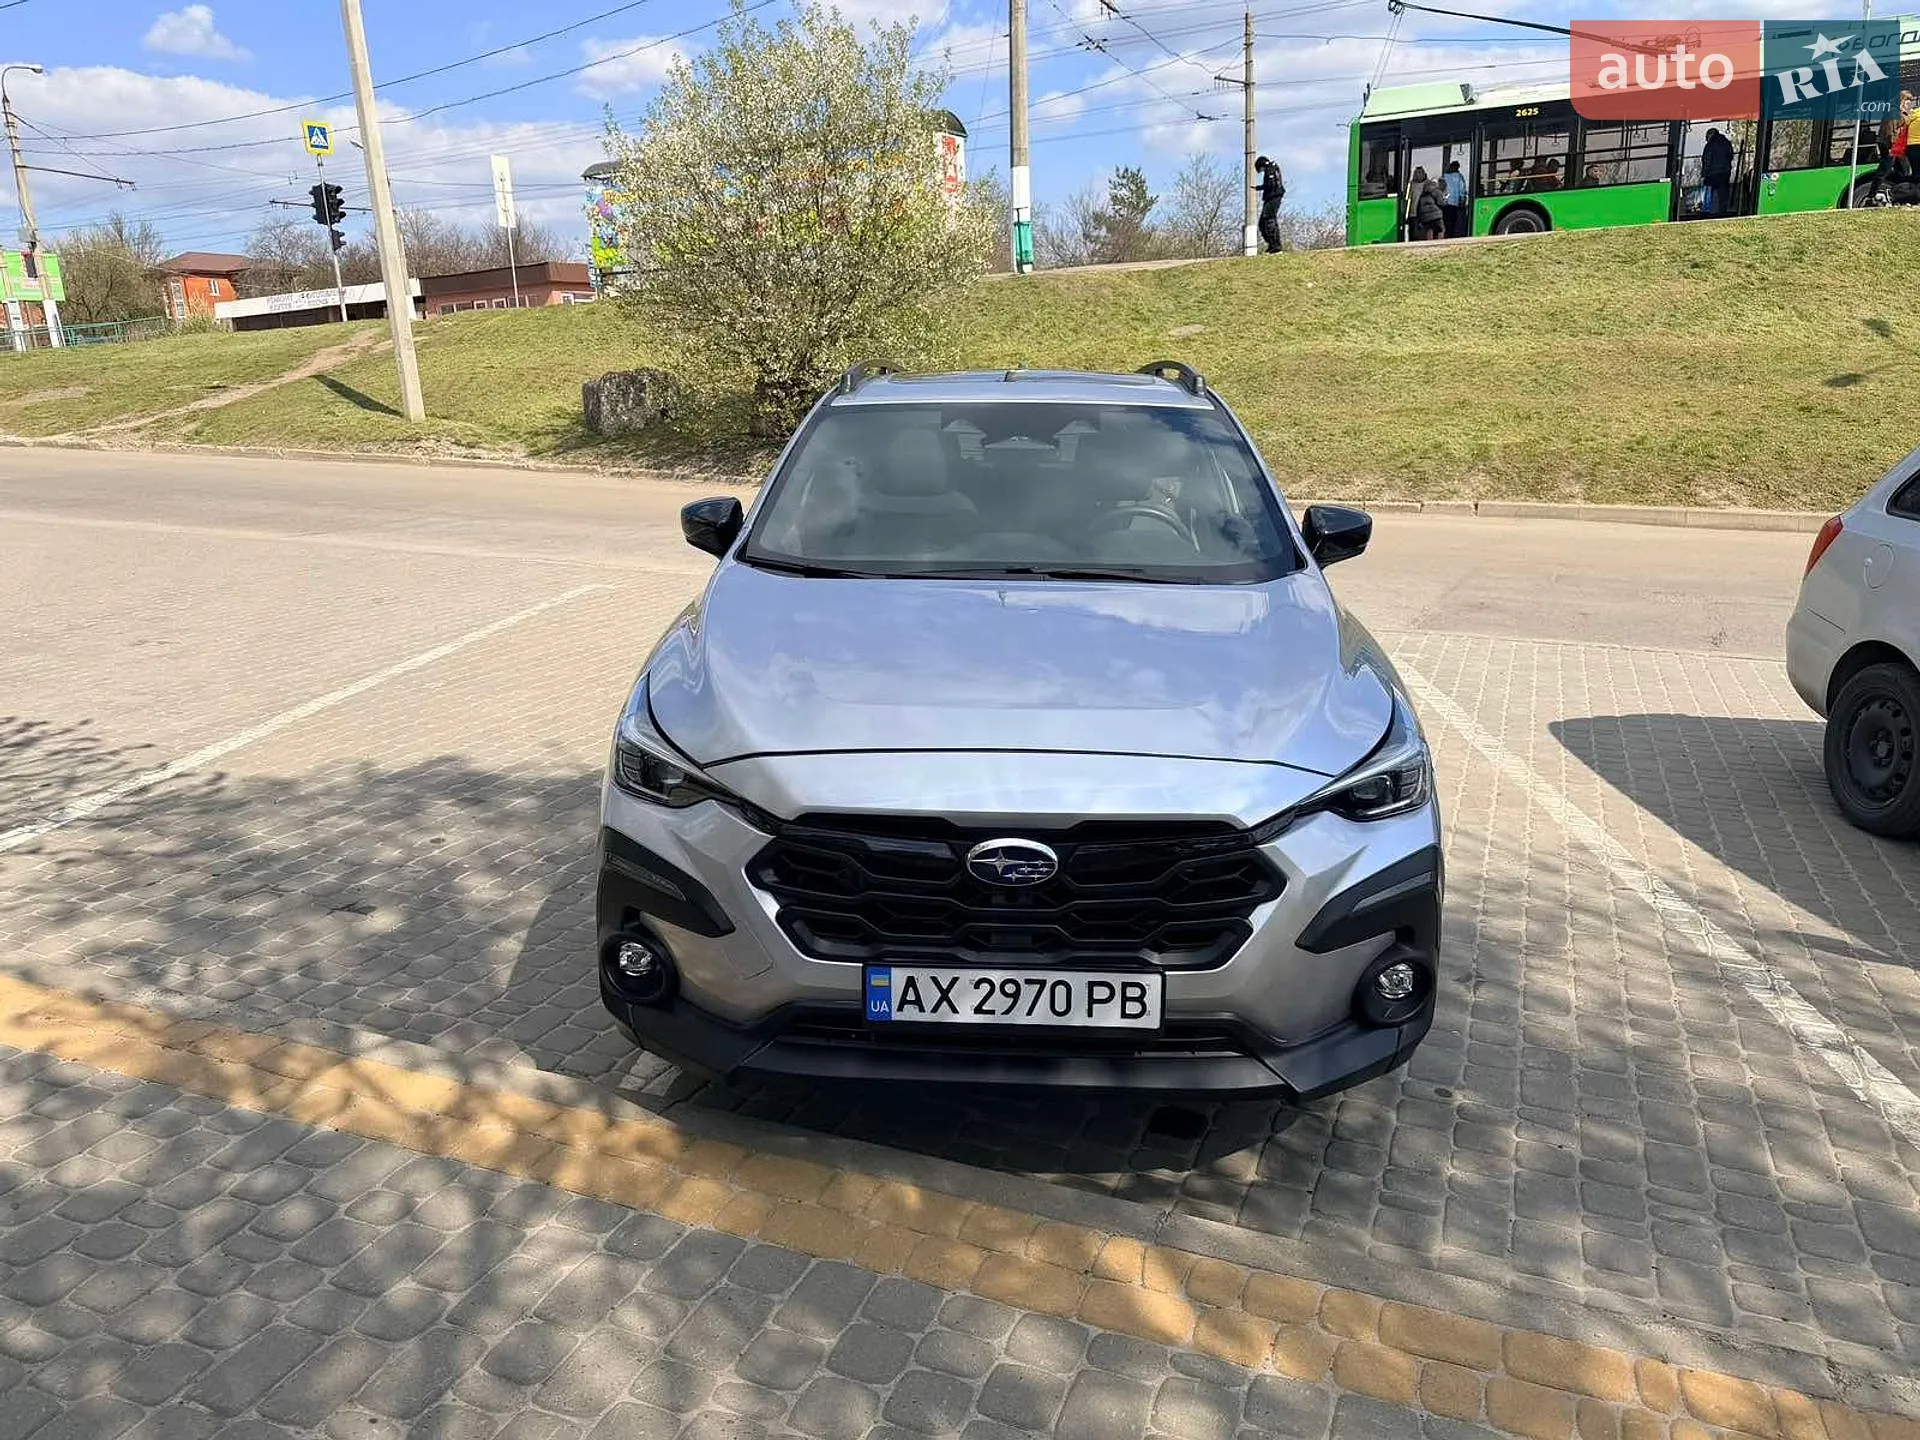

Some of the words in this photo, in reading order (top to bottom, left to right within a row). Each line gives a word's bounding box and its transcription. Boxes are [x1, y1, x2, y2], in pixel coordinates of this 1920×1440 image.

[1516, 107, 1539, 117] 2625
[896, 975, 960, 1014] AX
[973, 977, 1073, 1017] 2970
[1087, 981, 1147, 1019] PB
[871, 1000, 889, 1012] UA
